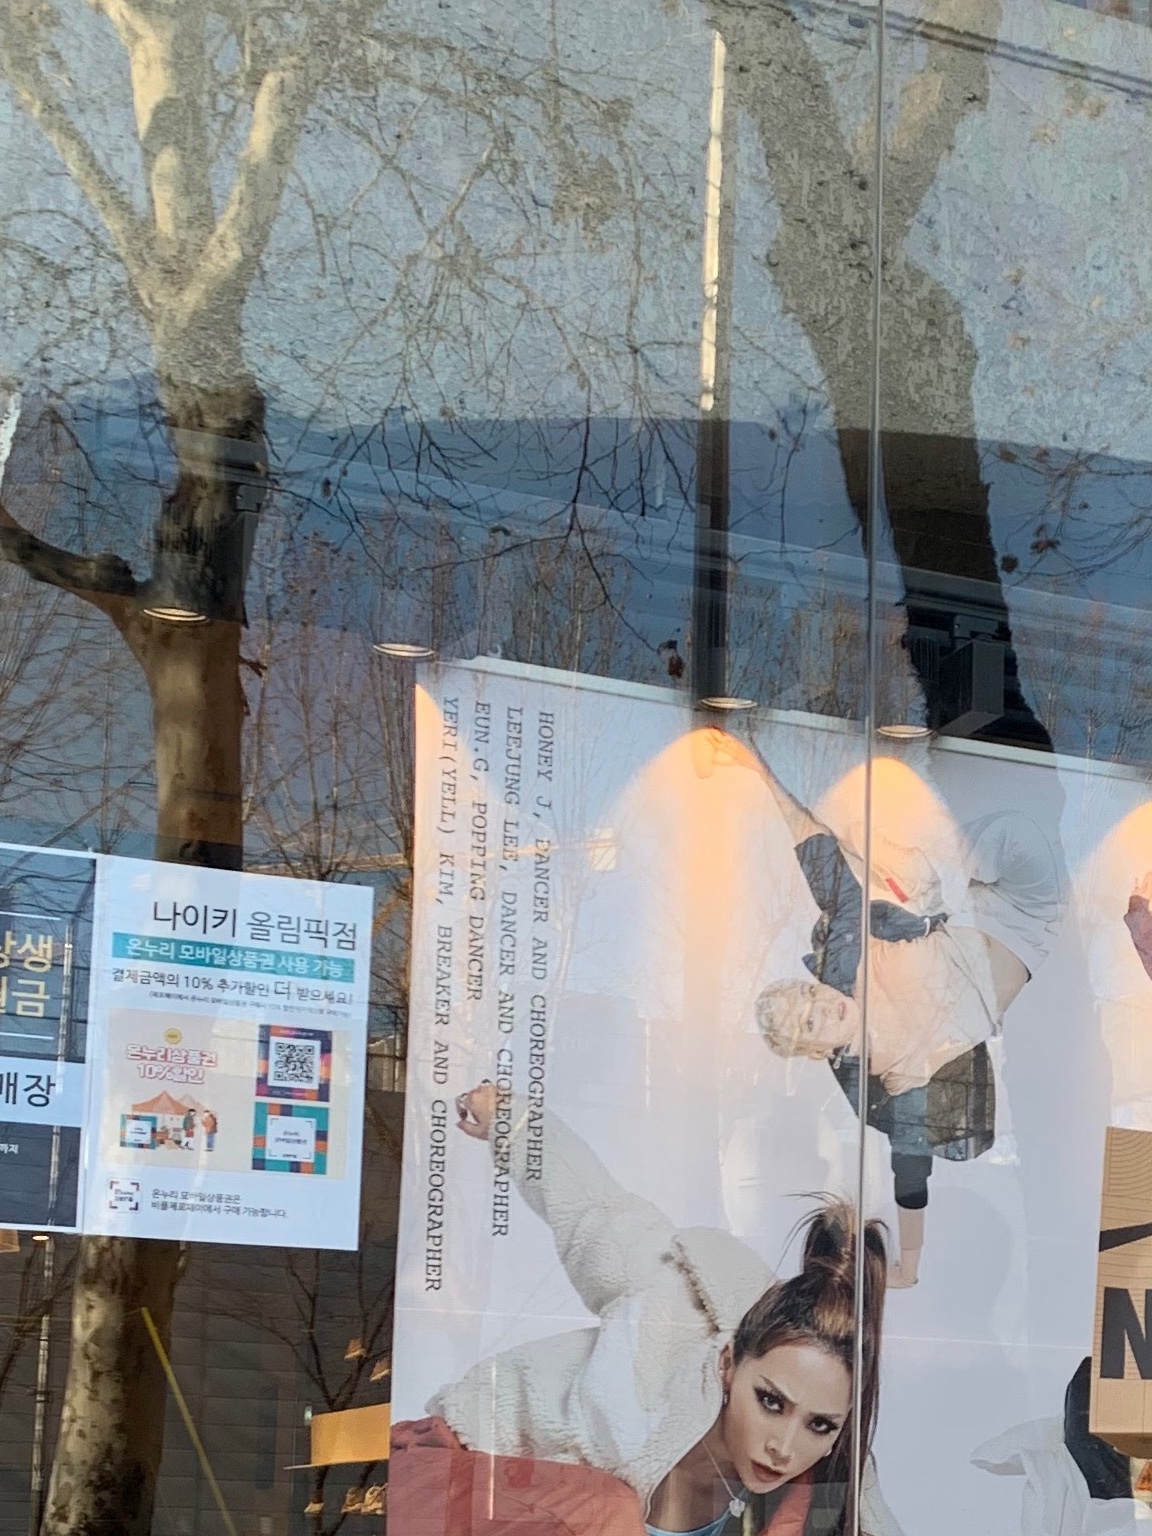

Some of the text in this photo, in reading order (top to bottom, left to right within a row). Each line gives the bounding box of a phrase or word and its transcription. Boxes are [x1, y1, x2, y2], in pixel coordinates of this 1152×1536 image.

[466, 700, 491, 1001] EUN.G, POPPING DANCER
[153, 901, 357, 950] 나이키 올림픽점
[525, 711, 554, 1181] HONEY J, DANCER AND CHOREOGRAPHER
[126, 938, 345, 978] 온누리 모바일상품권 사용 가능
[492, 706, 523, 1237] LEEJUNG LEE, DANCER AND CHOREOGRAPHER
[112, 967, 180, 988] 결제금액의
[184, 975, 213, 991] 10%
[216, 978, 270, 997] 추가할인
[274, 980, 291, 1000] 더
[297, 986, 353, 1004] 받으세요!
[425, 696, 459, 1292] YERI(YELL) KIM, BREAKER AND CHOREOGRAPHER
[126, 1044, 218, 1067] 온누리상품권
[151, 1188, 179, 1199] 온누리
[222, 1204, 241, 1216] 구매
